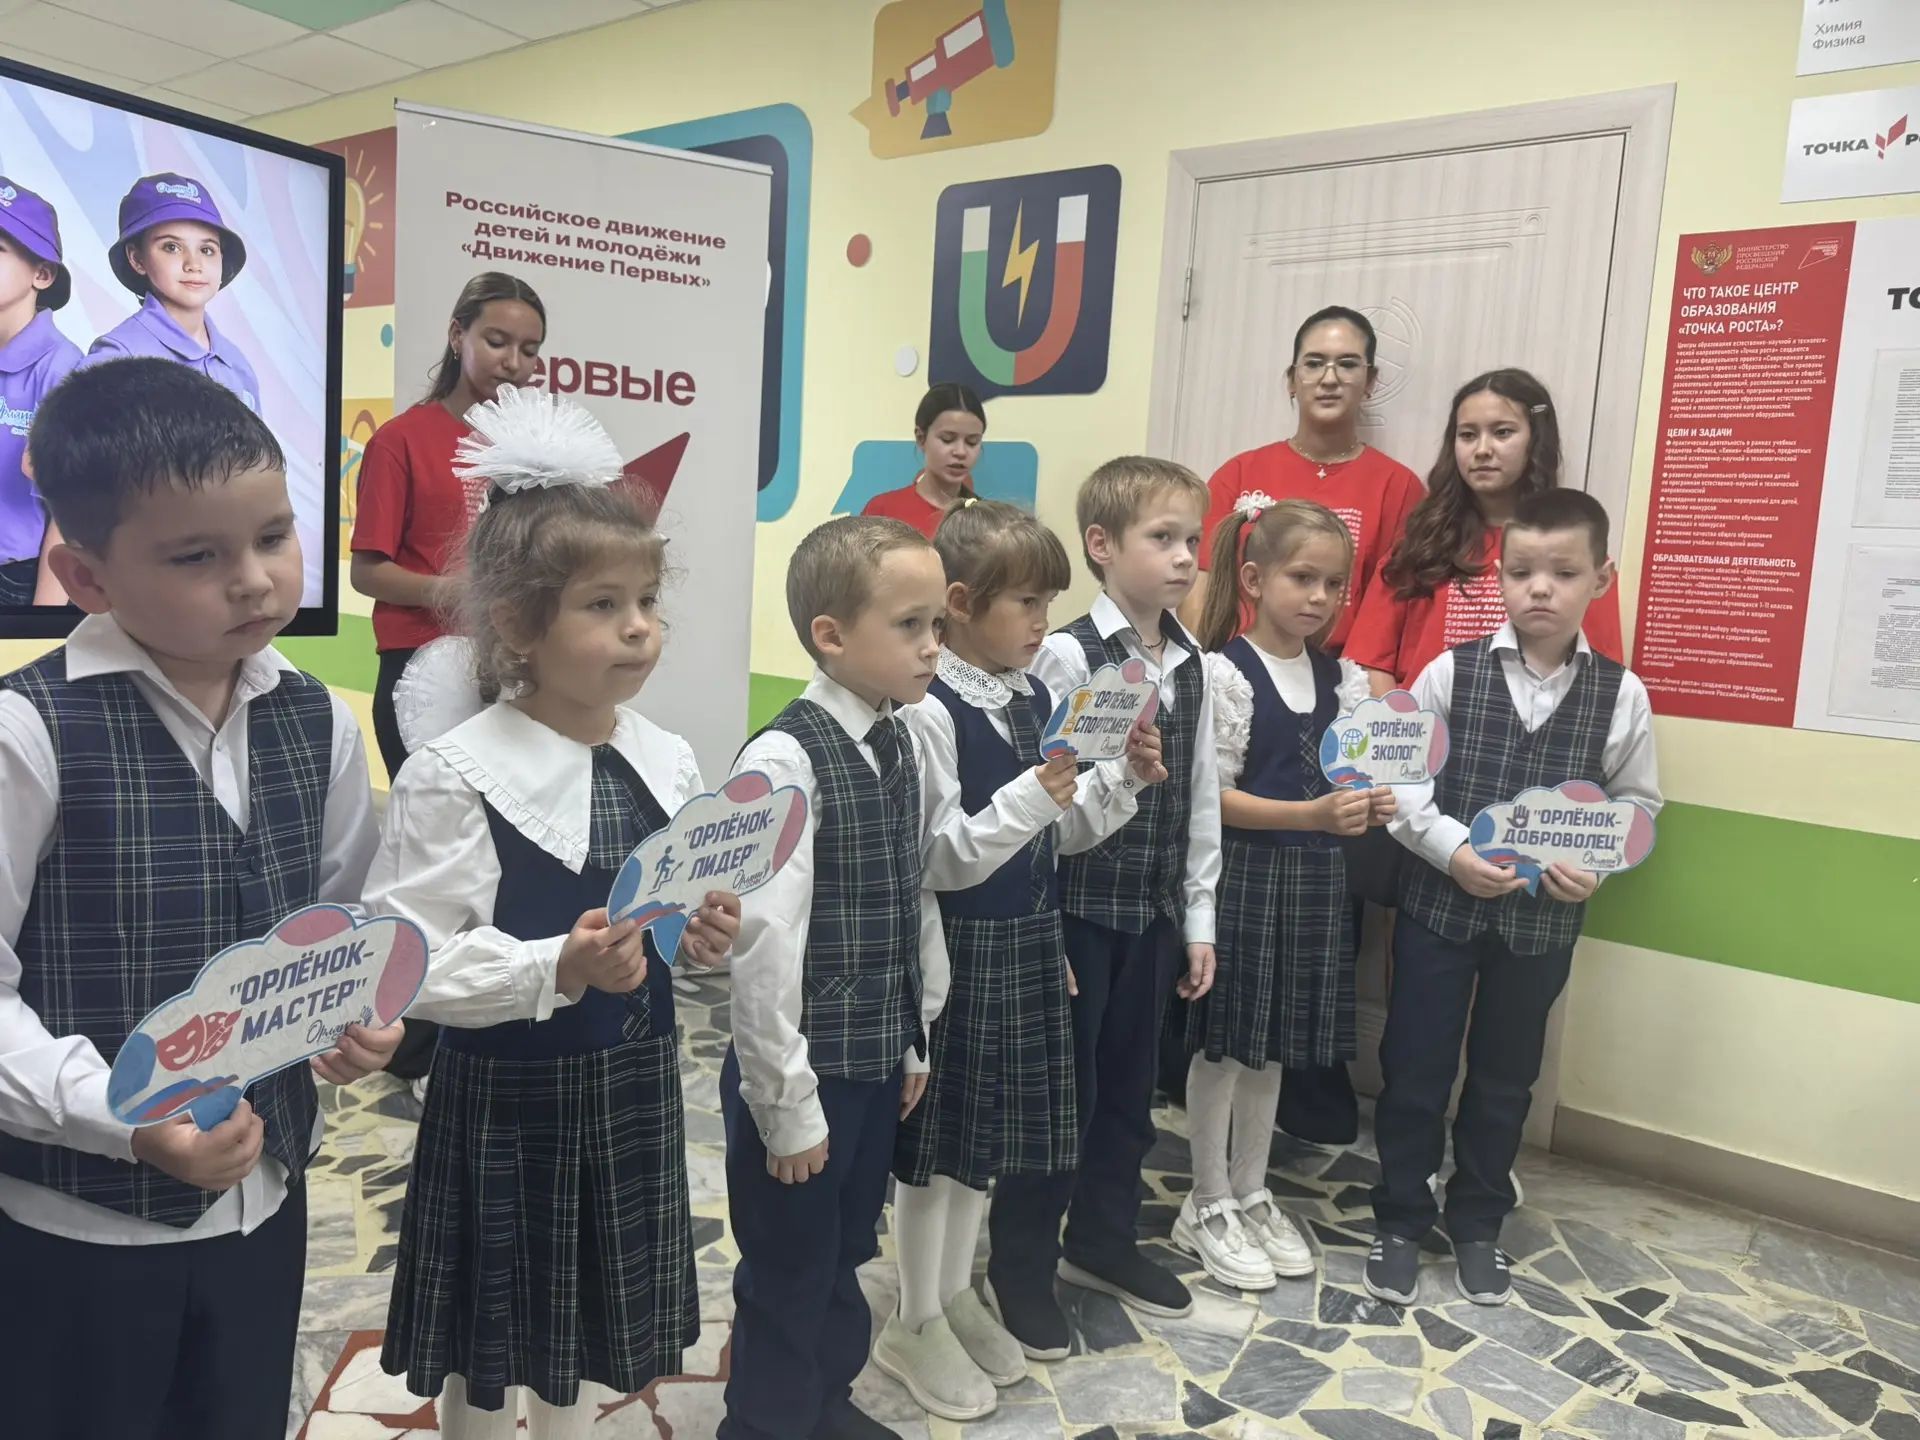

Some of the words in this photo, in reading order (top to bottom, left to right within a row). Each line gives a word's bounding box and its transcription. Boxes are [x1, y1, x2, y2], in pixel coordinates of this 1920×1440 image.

[1814, 20, 1863, 36] Химия
[1812, 34, 1866, 50] Физика
[1803, 138, 1869, 156] ТОЧКА
[446, 191, 601, 230] Российское
[606, 219, 726, 249] движение
[474, 221, 550, 244] детей
[556, 234, 571, 247] и
[577, 237, 701, 266] молодёжи
[461, 240, 605, 273] «Движение
[610, 260, 711, 287] Первых»
[1683, 287, 1706, 300] ЧТО
[1709, 284, 1751, 298] ТАКОЕ
[1754, 281, 1799, 297] ЦЕНТР
[1681, 301, 1777, 318] ОБРАЗОВАНИЯ
[1678, 321, 1725, 335] «ТОЧКА
[1729, 319, 1784, 333] РОСТА»?
[526, 356, 696, 406] ервые
[1667, 428, 1689, 438] ЦЕЛИ
[1690, 428, 1697, 436] И
[1699, 428, 1732, 438] ЗАДАЧИ
[1653, 554, 1730, 564] ОБРАЗОВАТЕЛЬНАЯ
[1732, 556, 1796, 568] ДЕЯТЕЛЬНОСТЬ
[1366, 718, 1427, 738] "ОРЛЁНОК-
[1371, 745, 1421, 761] ЭКОЛОГ"
[1533, 807, 1622, 828] "ОРЛЁНОК-
[684, 807, 775, 850] "ОРЛЁНОК-
[1502, 828, 1623, 850] ДОБРОВОЛЕЦ"
[688, 842, 760, 882] ЛИДЕР"
[230, 939, 375, 1006] "ОРЛЁНОК-
[240, 977, 368, 1044] МАСТЕР"
